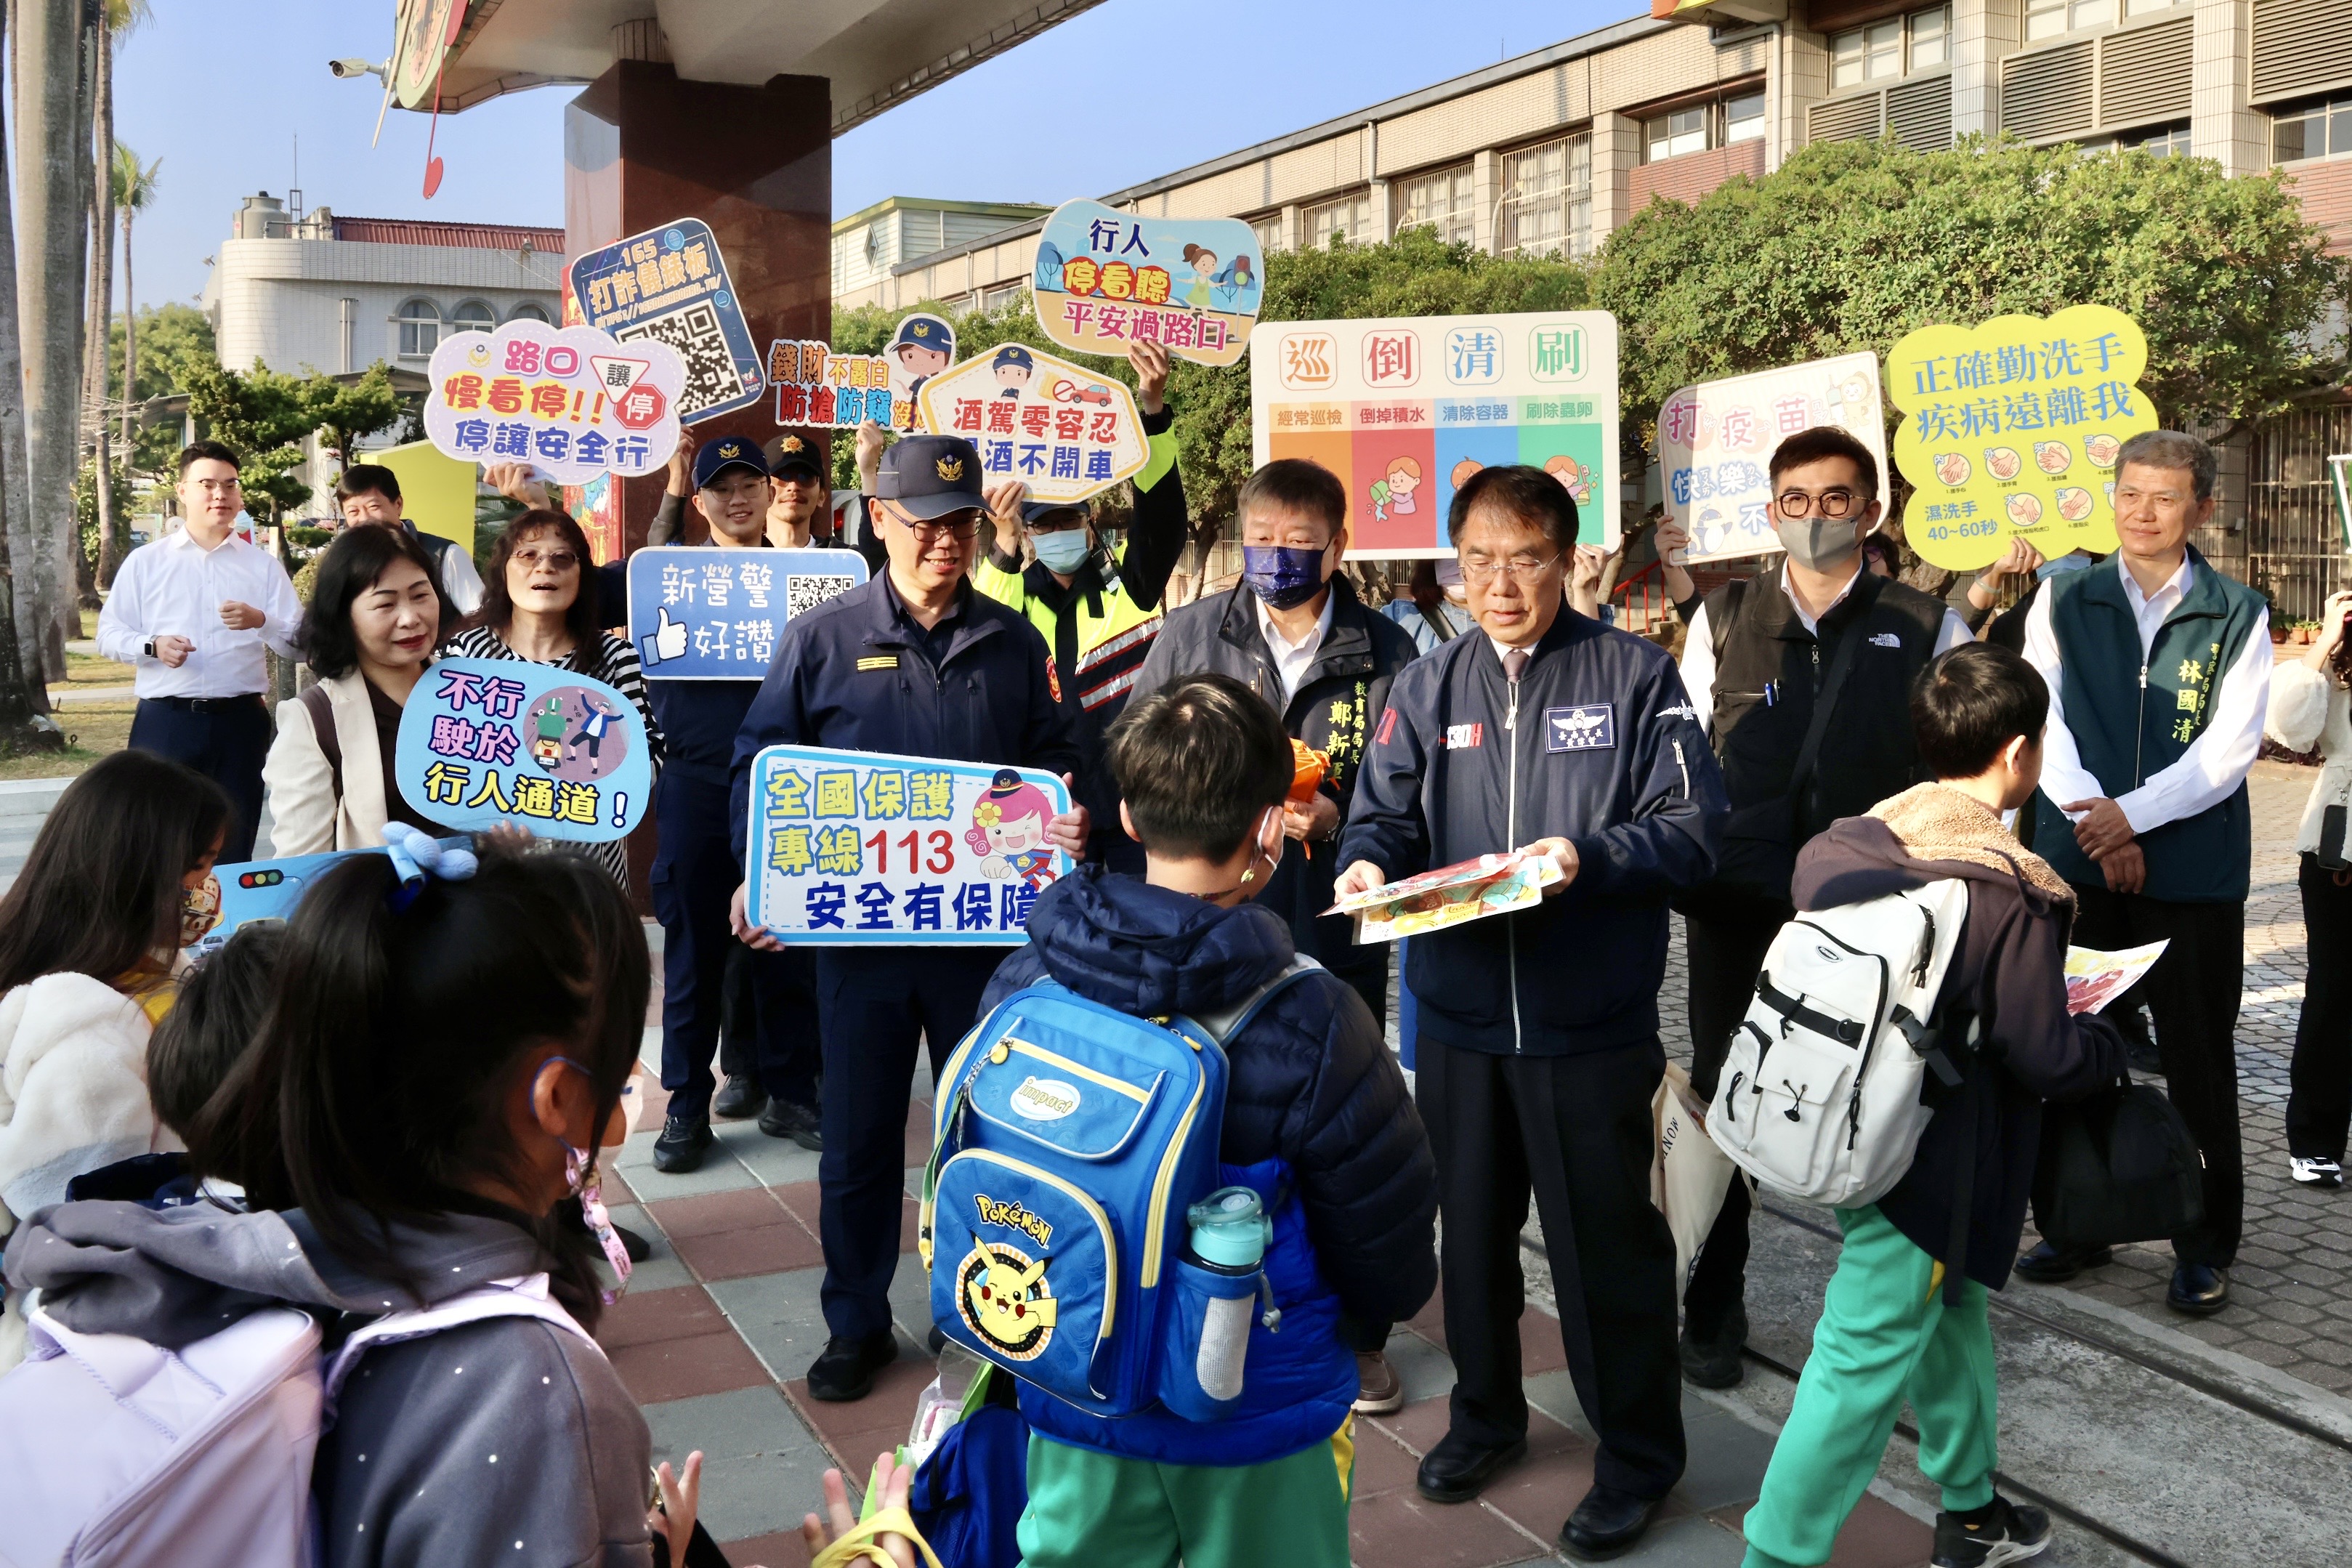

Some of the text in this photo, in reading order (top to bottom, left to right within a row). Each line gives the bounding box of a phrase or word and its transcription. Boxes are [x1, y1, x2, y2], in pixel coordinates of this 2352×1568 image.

[621, 238, 658, 267] 165
[1090, 219, 1149, 257] 行人
[589, 242, 711, 315] 打詐儀錶板
[1064, 261, 1171, 304] 停看聽
[1064, 301, 1228, 351] 平安過路口
[504, 340, 578, 375] 路口
[607, 364, 630, 387] 讓
[771, 343, 890, 388] 錢財不露白
[1286, 329, 1580, 383] 巡 倒 清 刷
[1910, 332, 2125, 395] 正確勤洗手
[625, 392, 654, 420] 停
[953, 397, 1117, 444] 酒駕零容忍
[1277, 401, 1593, 427] 經常巡檢 倒掉積水 清除容器 刷除蟲卵
[1668, 398, 1805, 447] 打疫苗
[1916, 381, 2135, 444] 疾病遠離我
[454, 419, 650, 467] 停讓安全行
[965, 437, 1113, 481] 酒不開車
[1984, 448, 1995, 459] 外
[2034, 442, 2045, 453] 夾
[2083, 435, 2095, 446] 弓
[1674, 462, 1771, 502] 快樂
[2004, 493, 2016, 505] 大
[2055, 488, 2067, 500] 立
[1928, 519, 1997, 541] 40~60秒
[661, 561, 774, 608] 新營警
[693, 618, 775, 663] 好讚
[436, 669, 525, 719] 不行
[2172, 659, 2203, 743] 林國清
[428, 715, 521, 767] 駛於
[1349, 681, 1367, 764] 教育局局長
[1438, 722, 1483, 750] -130H
[765, 767, 955, 821] 全國保護
[767, 823, 955, 878] 專線113
[805, 881, 1040, 931] 安全有保障
[1019, 1079, 1073, 1114] impact
